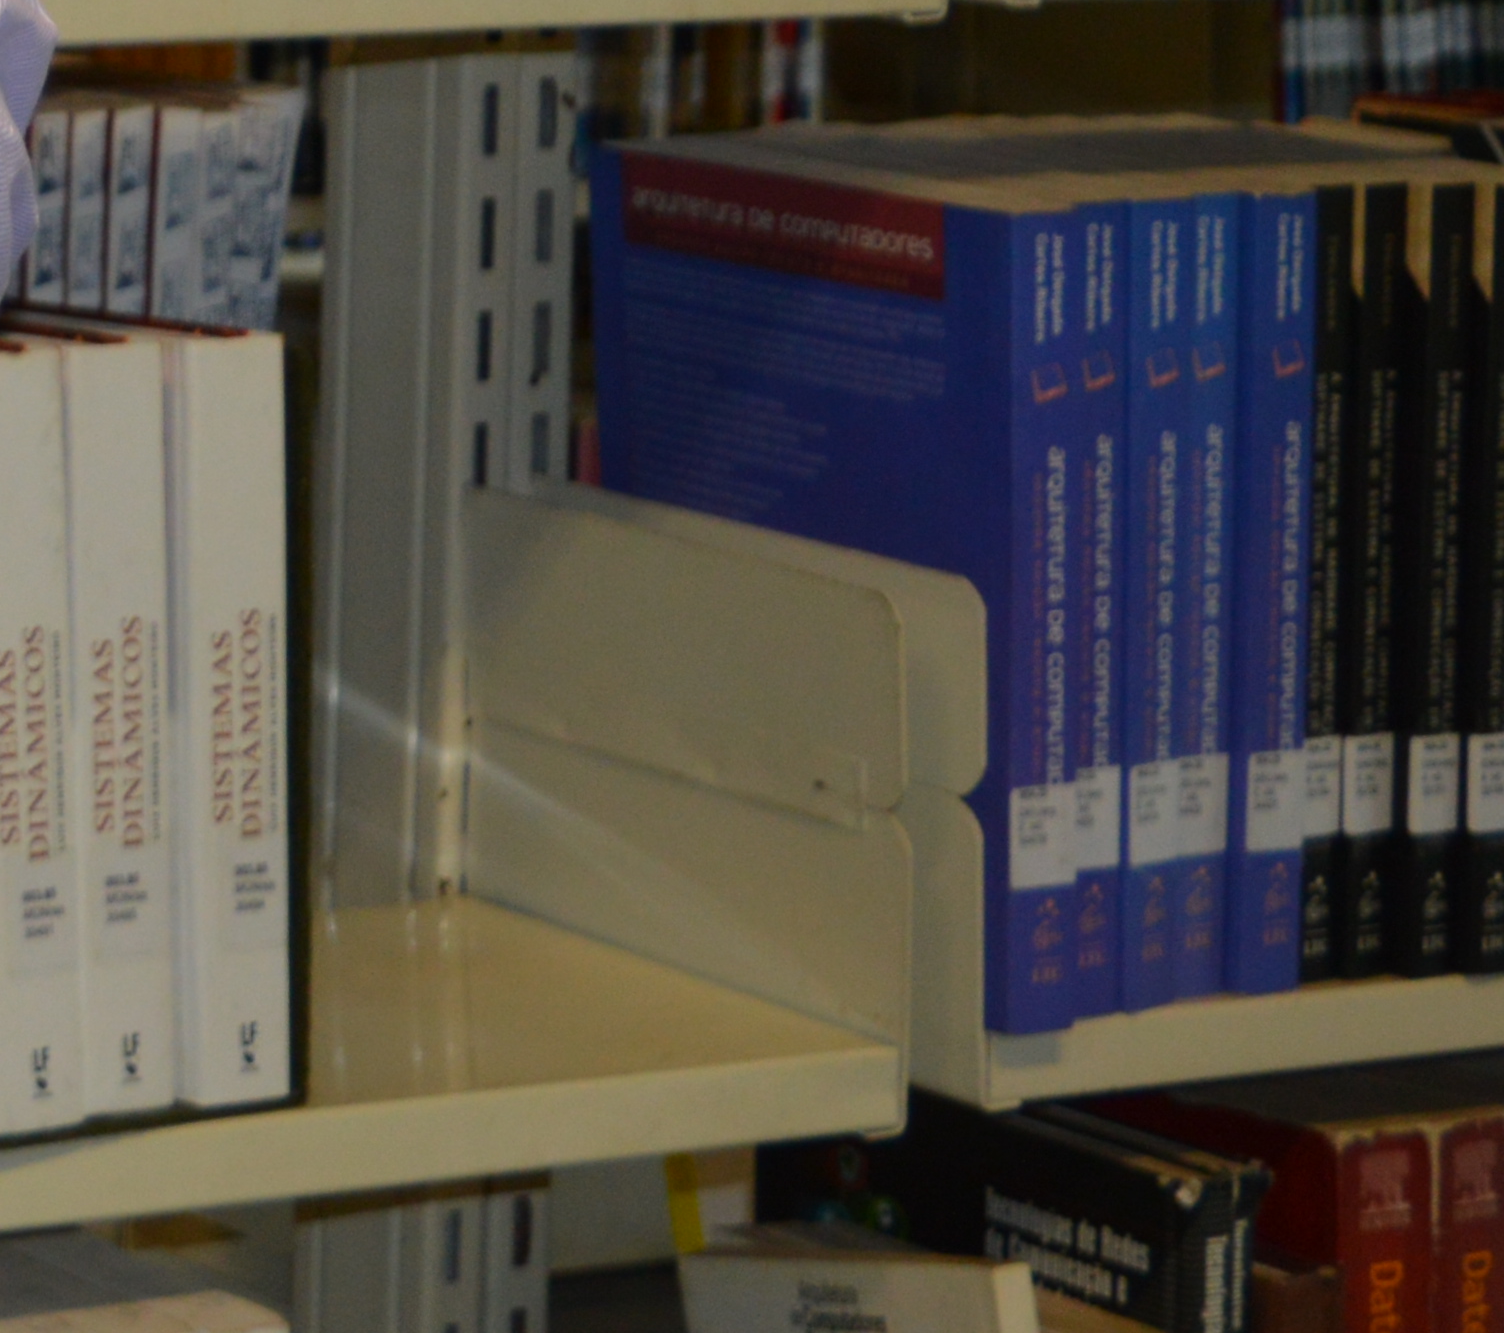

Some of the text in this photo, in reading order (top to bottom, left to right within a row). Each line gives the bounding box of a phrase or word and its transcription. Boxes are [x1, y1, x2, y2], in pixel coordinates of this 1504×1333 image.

[21, 625, 50, 861] DINÂMICOS
[92, 637, 116, 833] SISTEMAS
[117, 615, 144, 848] DINÂMICOS
[212, 629, 233, 824] SISTEMAS
[235, 607, 262, 840] DINÂMICOS
